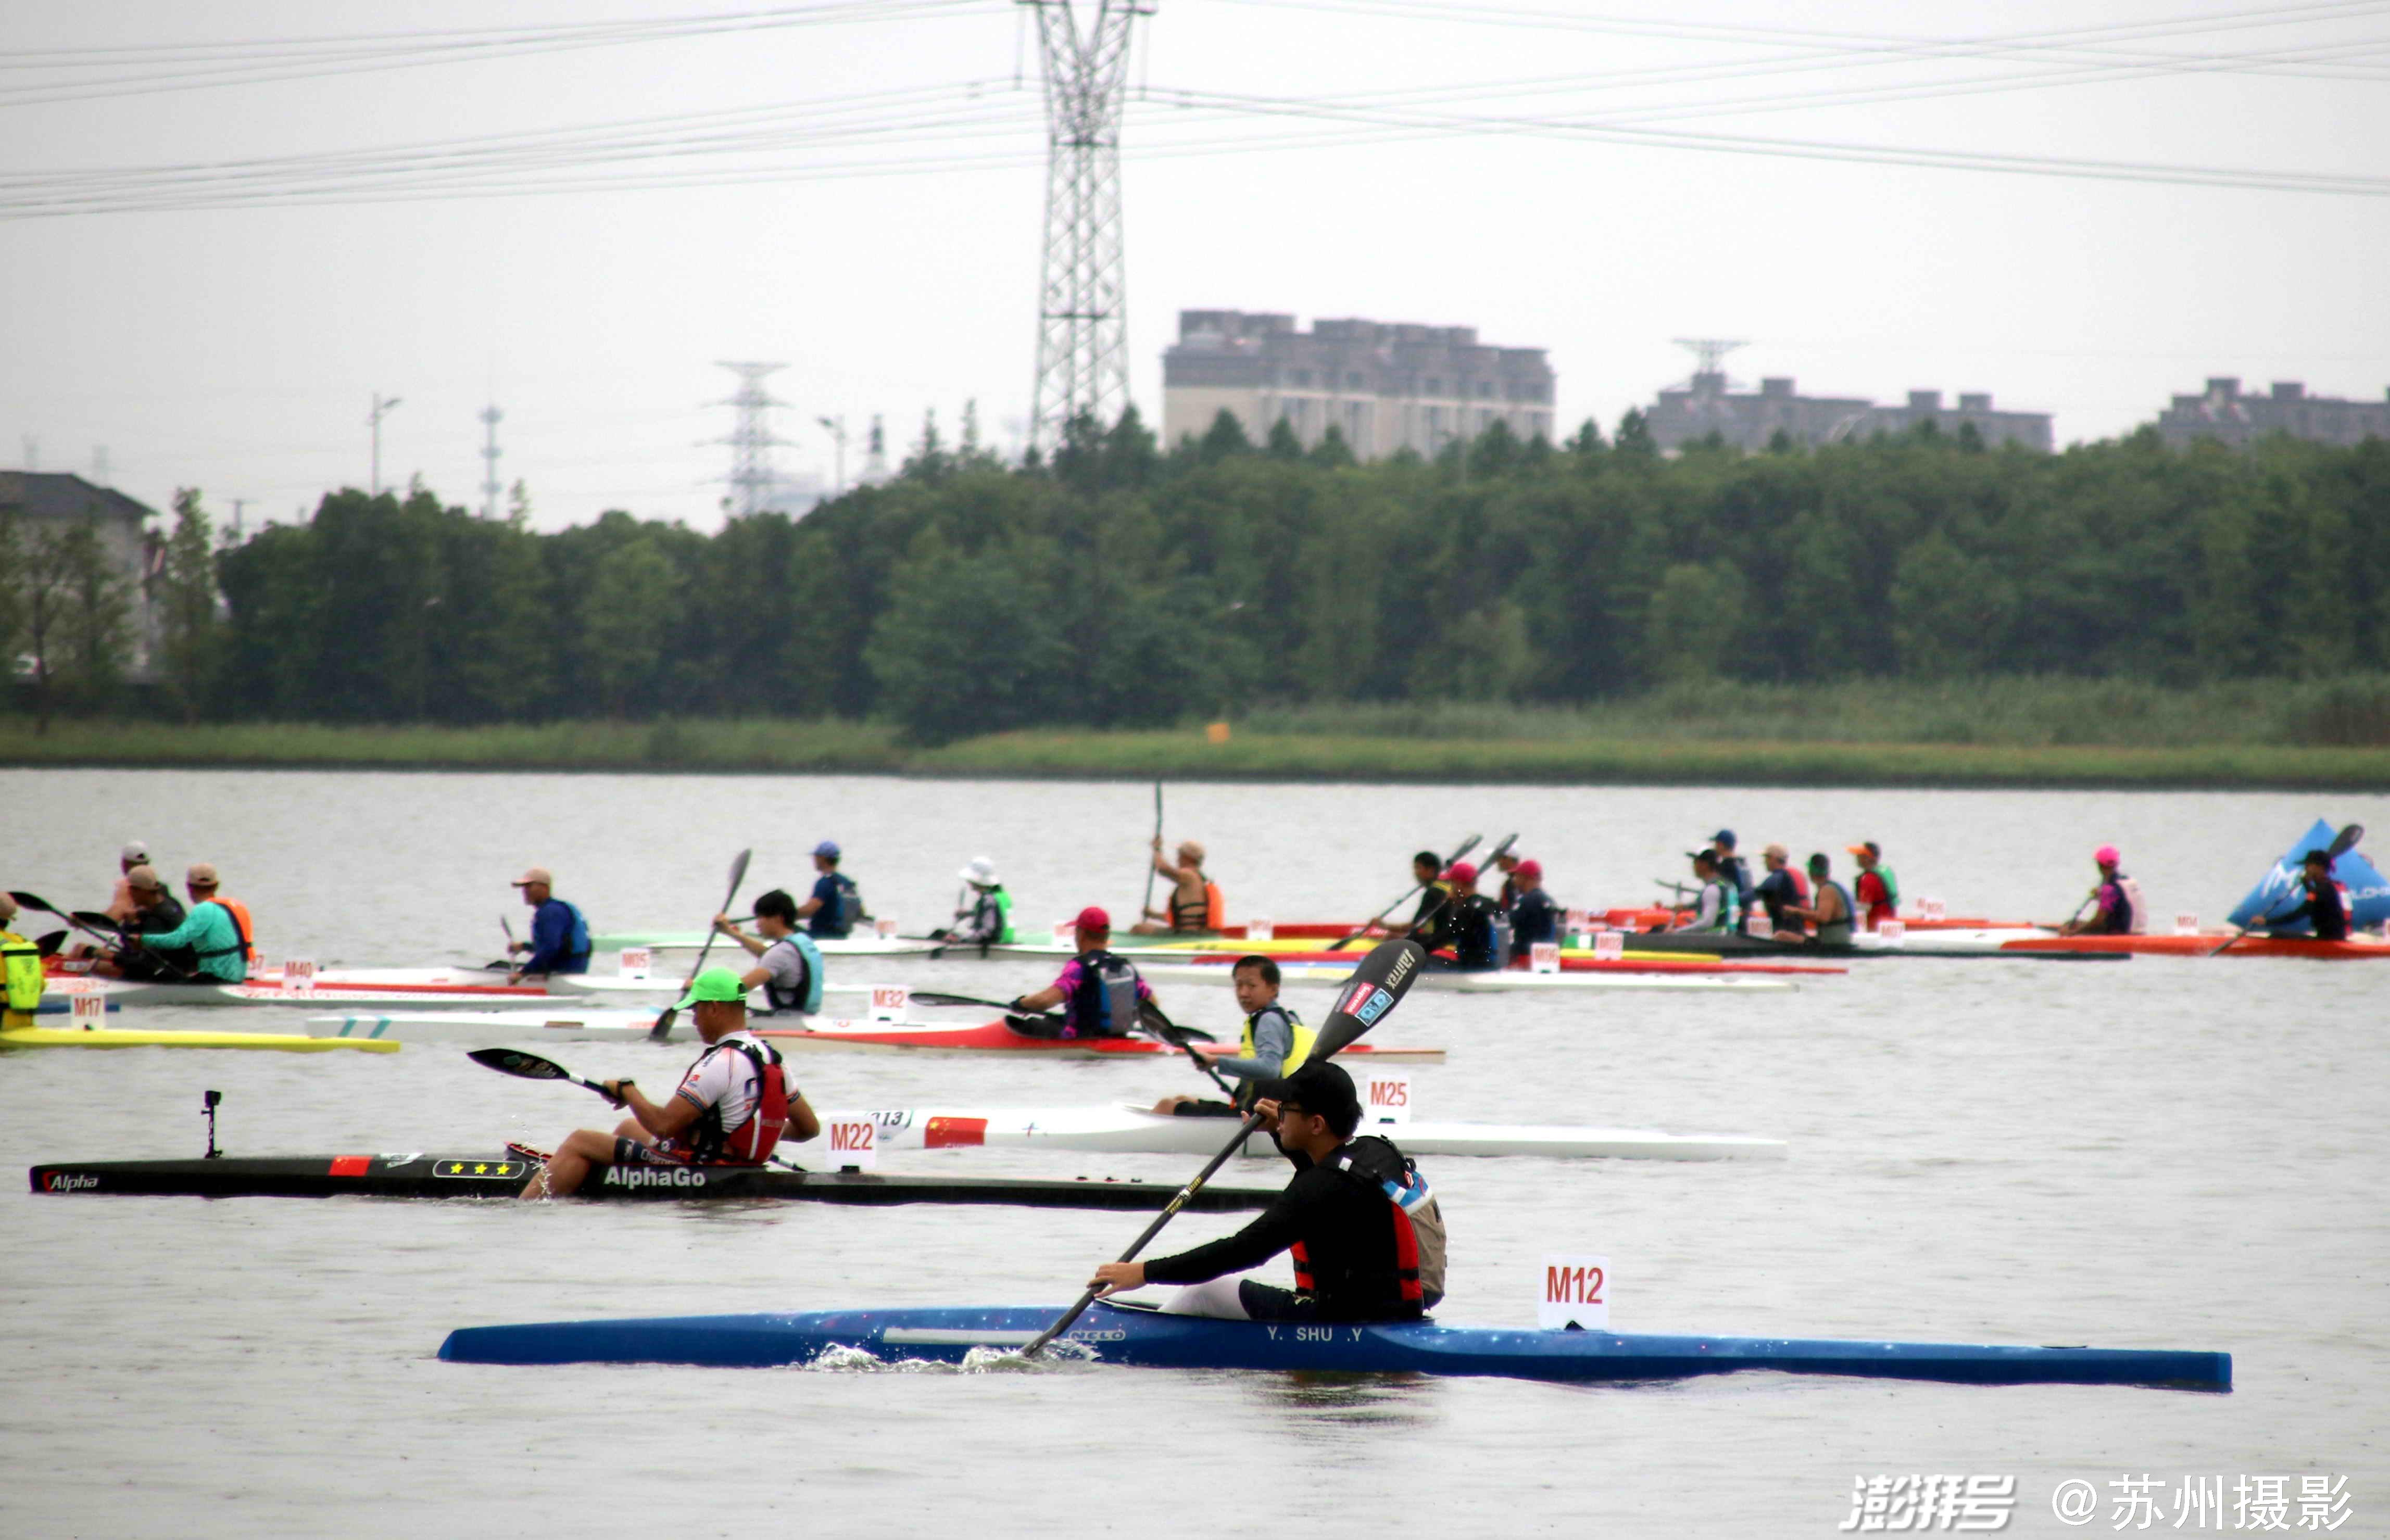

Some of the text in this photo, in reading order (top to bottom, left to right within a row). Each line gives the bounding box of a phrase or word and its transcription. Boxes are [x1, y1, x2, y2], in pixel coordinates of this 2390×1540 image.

[285, 961, 312, 977] M40
[74, 997, 100, 1016] M17
[873, 990, 905, 1008] M32
[1370, 1081, 1407, 1106] M25
[831, 1123, 873, 1151] M22
[51, 1175, 99, 1192] Alpha
[604, 1166, 706, 1190] AlphaGo
[1547, 1266, 1603, 1304] M12
[1296, 1327, 1333, 1342] SHU
